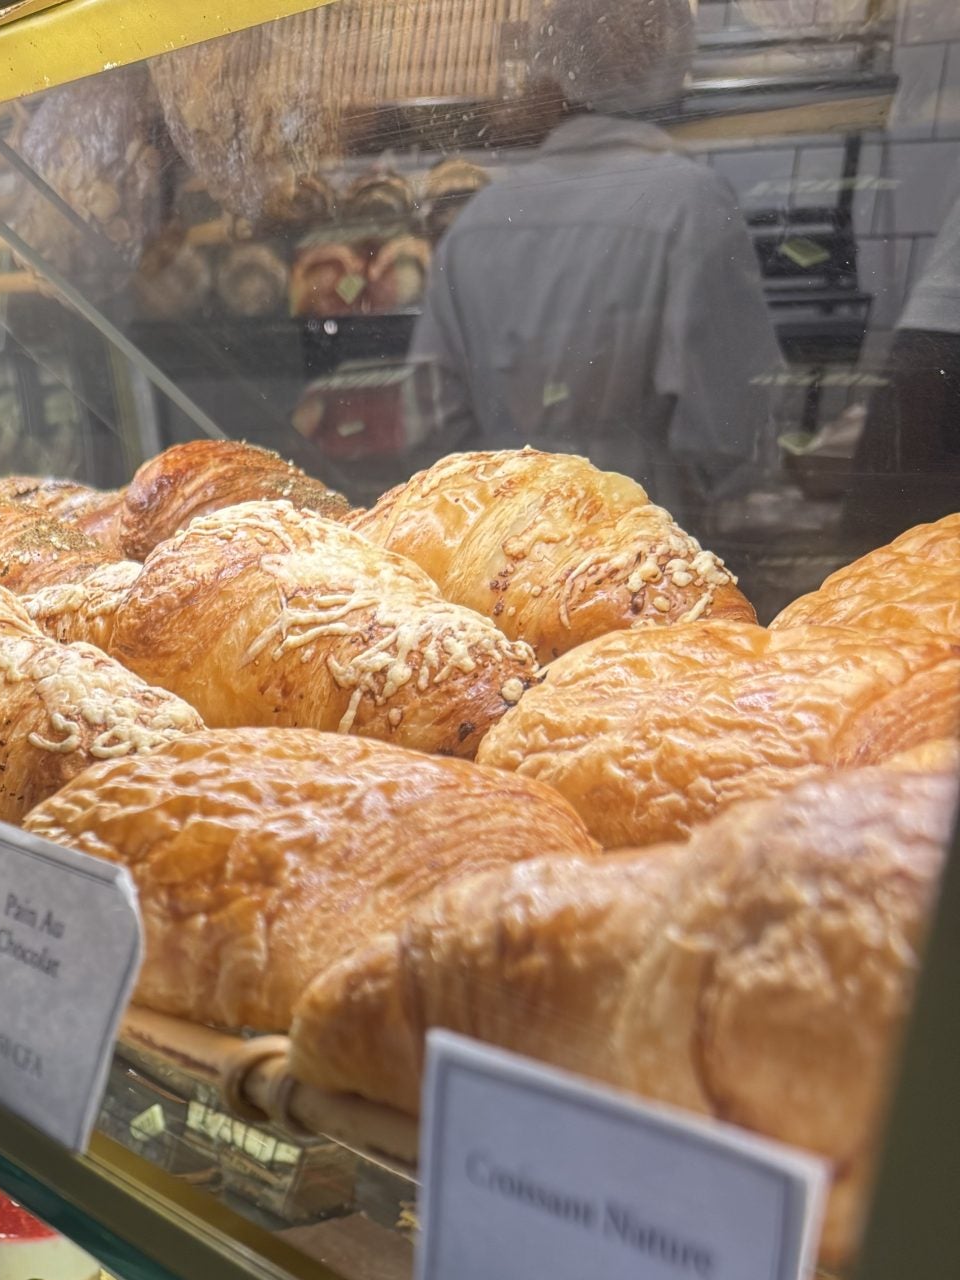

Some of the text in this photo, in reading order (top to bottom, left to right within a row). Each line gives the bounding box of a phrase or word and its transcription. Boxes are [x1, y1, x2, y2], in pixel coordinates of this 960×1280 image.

[4, 892, 65, 939] Pain Au
[465, 1151, 713, 1279] Croissant Nature
